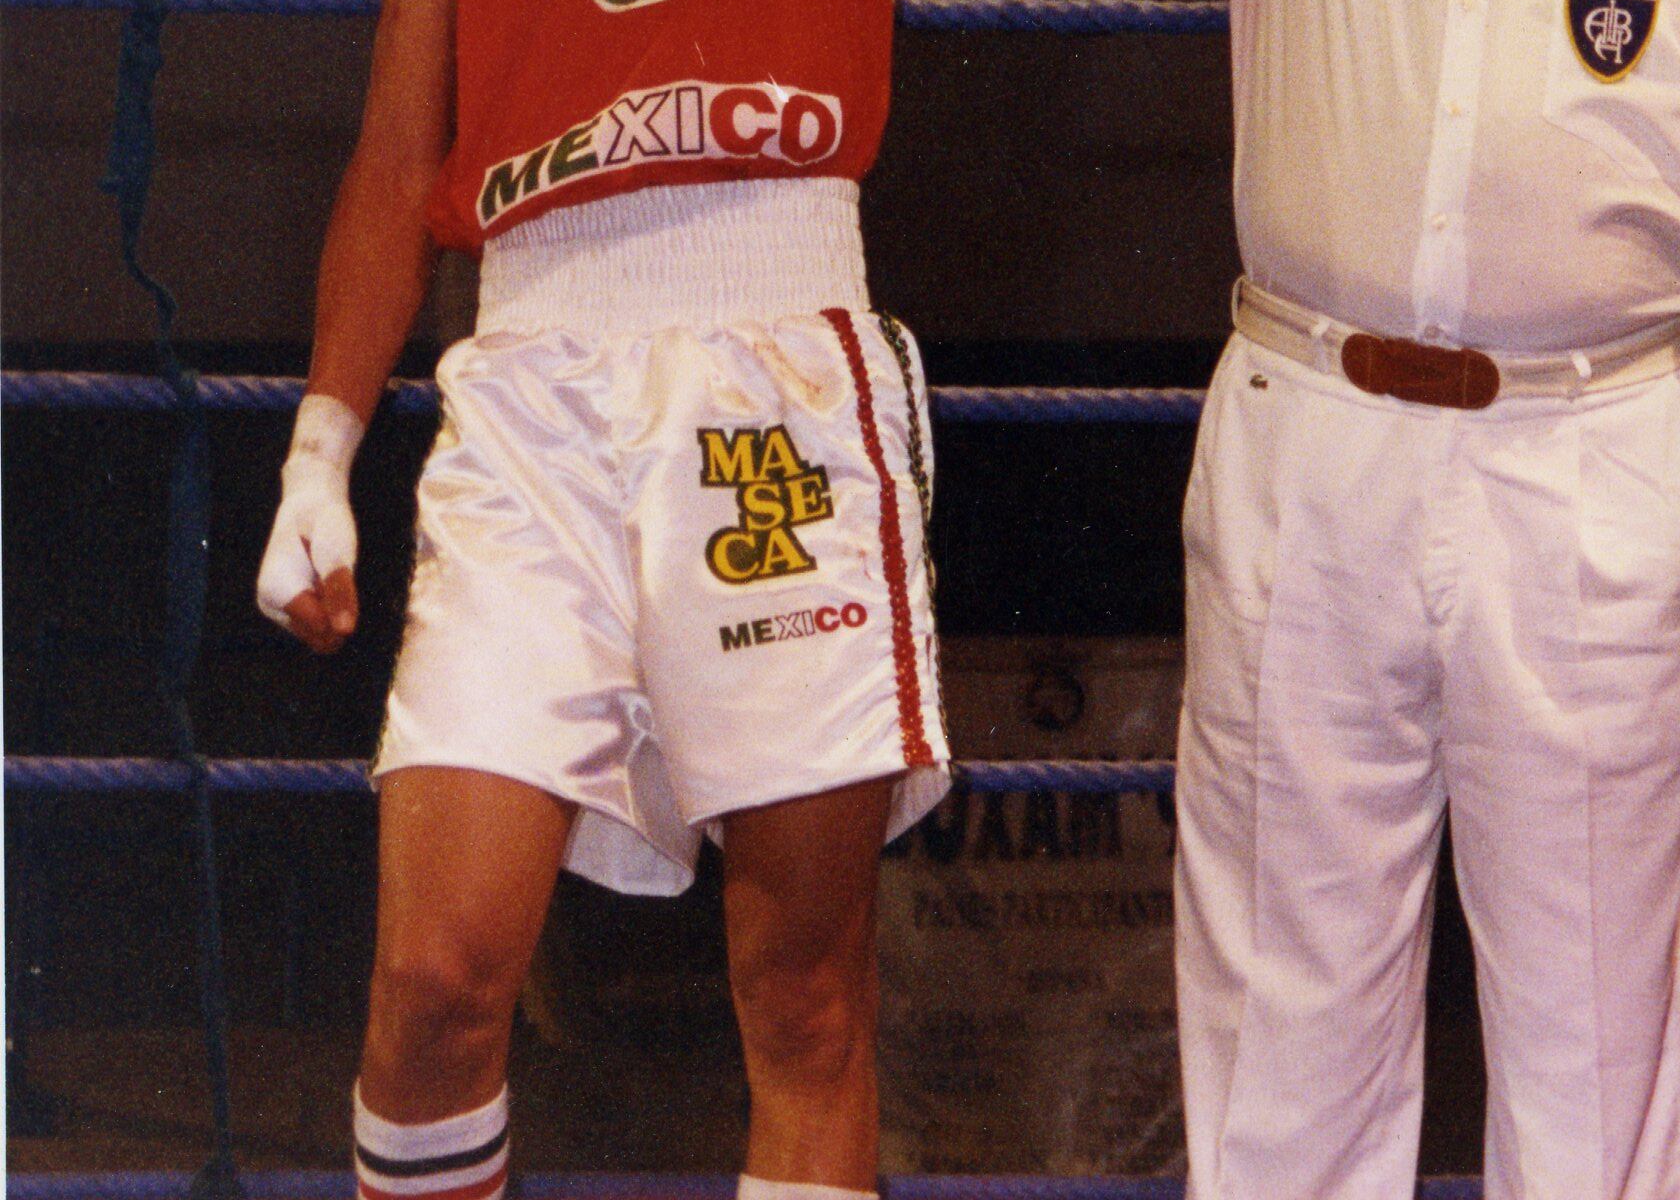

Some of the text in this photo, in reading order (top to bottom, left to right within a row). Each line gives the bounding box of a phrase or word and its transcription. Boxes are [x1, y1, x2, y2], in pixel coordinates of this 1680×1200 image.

[481, 86, 838, 222] MEXICO
[701, 427, 805, 486] MA
[740, 473, 833, 533] SE
[709, 528, 813, 583] CA
[718, 601, 869, 652] MEXICO
